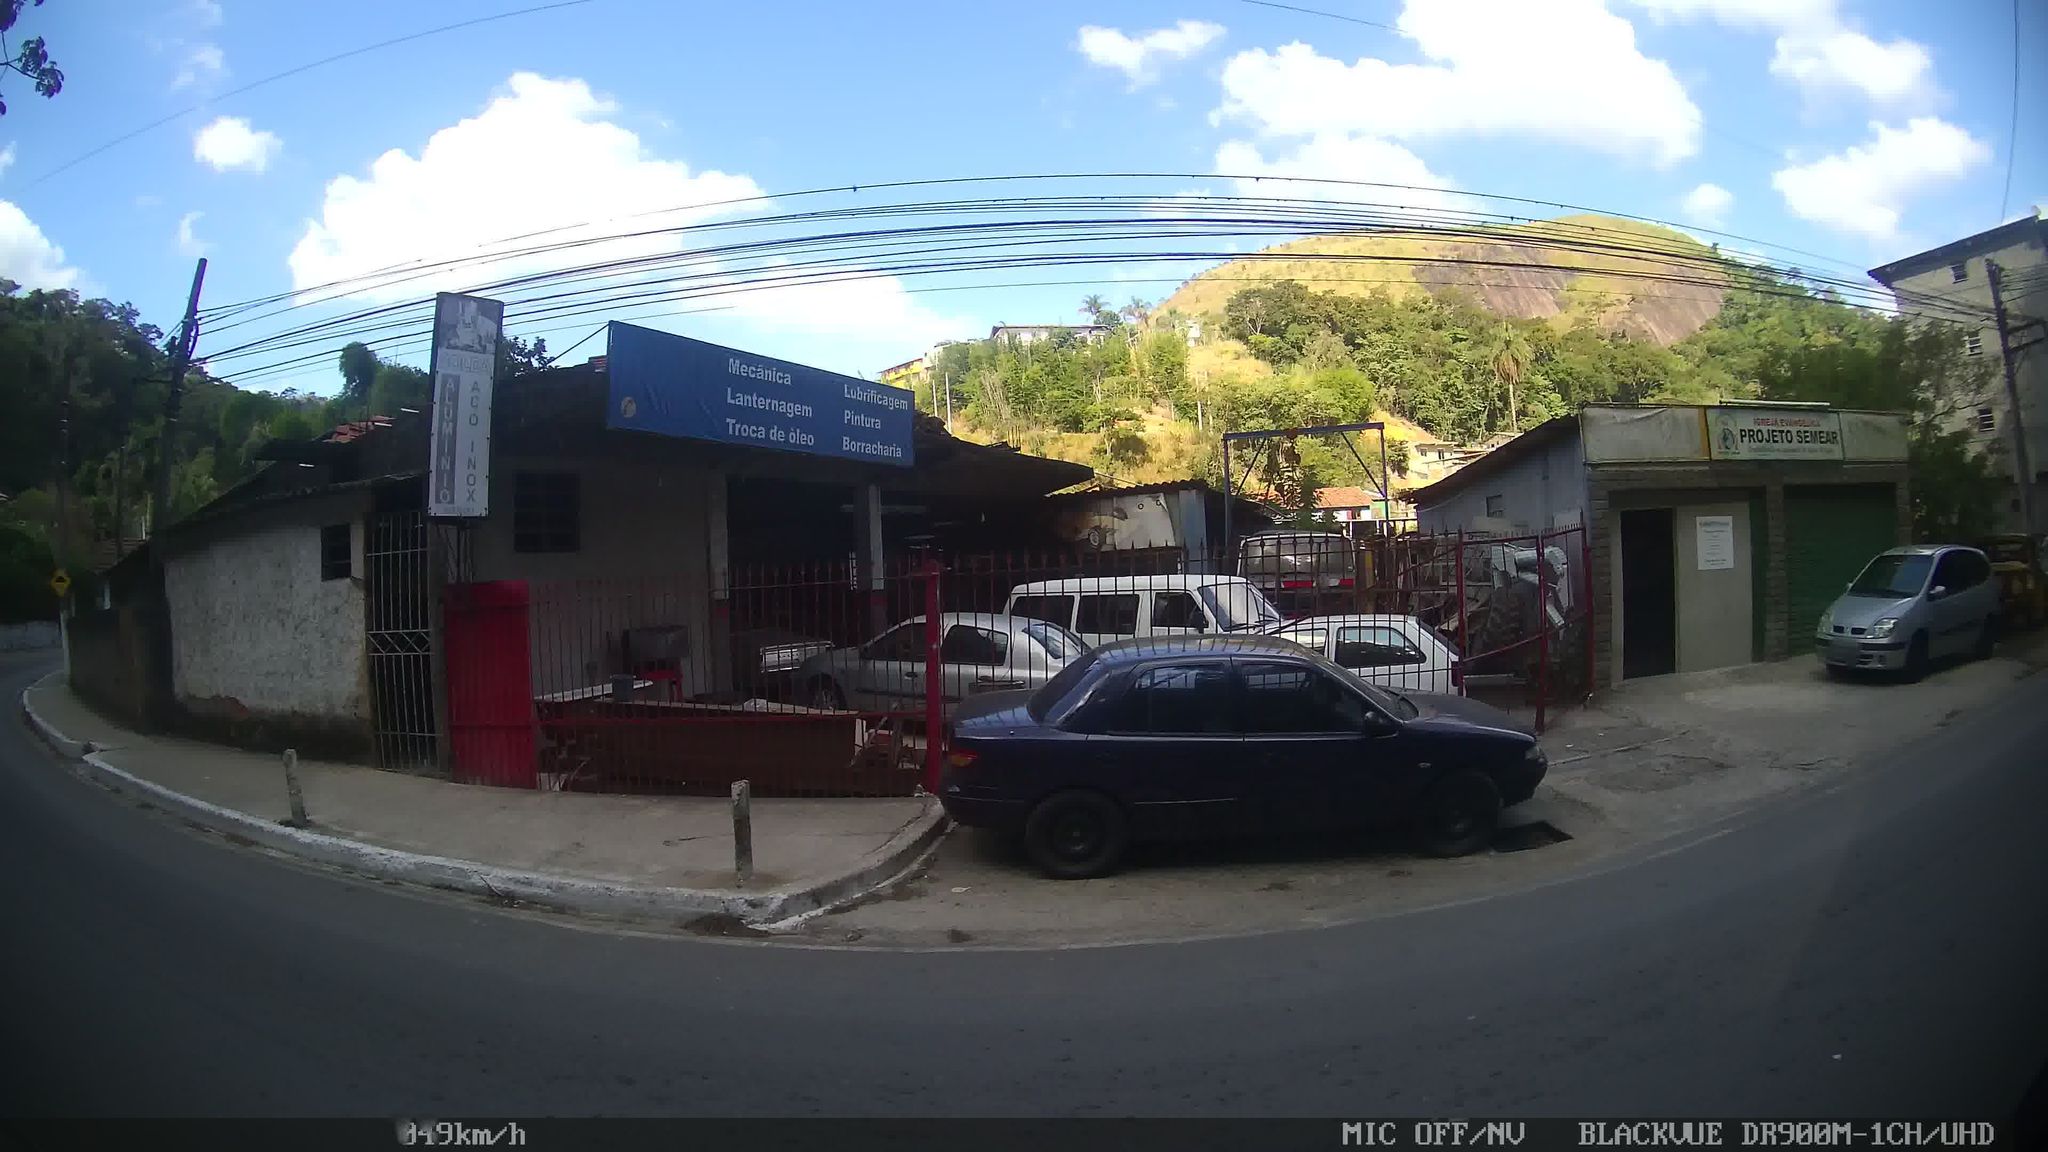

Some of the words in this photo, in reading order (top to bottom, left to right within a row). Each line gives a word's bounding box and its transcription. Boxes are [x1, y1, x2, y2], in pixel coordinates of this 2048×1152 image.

[728, 358, 791, 385] Mecânica
[727, 387, 812, 418] Lanternagem
[844, 384, 908, 410] Lubrificagem
[726, 418, 765, 439] Troca
[769, 425, 785, 442] de
[844, 410, 880, 429] Pintura
[842, 436, 902, 457] Borracharia
[1740, 429, 1793, 443] PROJETO
[1797, 430, 1838, 444] SEMEAR
[466, 441, 477, 502] INOX
